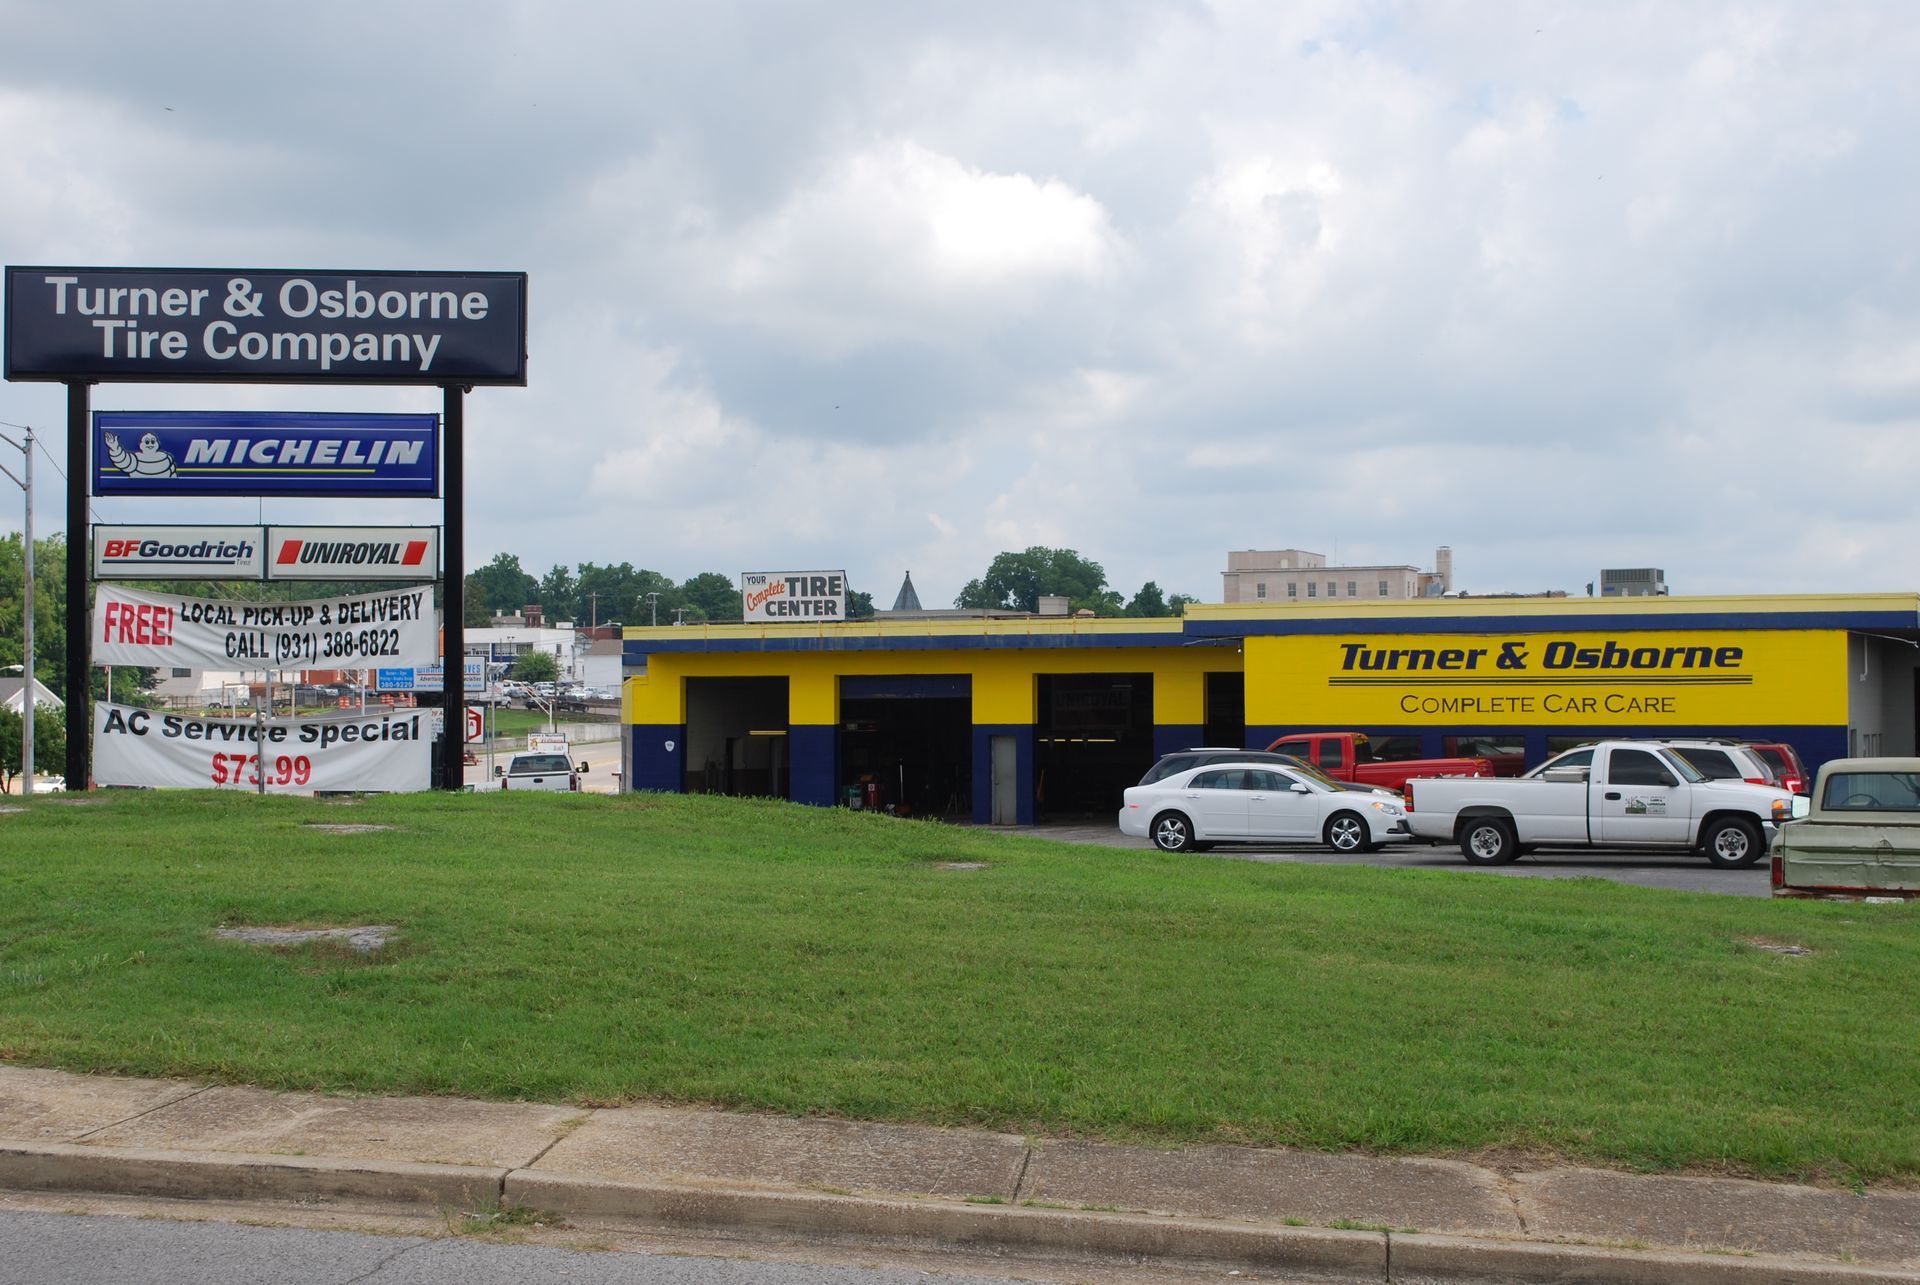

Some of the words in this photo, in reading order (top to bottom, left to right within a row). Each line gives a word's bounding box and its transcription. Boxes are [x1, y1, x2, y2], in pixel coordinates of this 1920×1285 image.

[45, 277, 209, 316] Turner
[223, 278, 265, 318] &
[279, 279, 489, 319] Osborne
[93, 320, 188, 359] Tire
[203, 321, 441, 370] Company
[184, 439, 424, 465] MICHELIN
[103, 539, 254, 558] BFGoodrich
[300, 542, 401, 565] UNIROYAL
[746, 576, 766, 584] YOUR
[747, 579, 785, 611] Complete
[785, 576, 841, 597] TIRE
[181, 602, 237, 625] LOCAL
[242, 605, 314, 626] PICK-UP
[320, 604, 331, 624] &
[338, 593, 423, 623] DELIVERY
[765, 600, 837, 616] CENTER
[104, 602, 174, 646] FREE!
[225, 631, 270, 659] CALL
[275, 632, 317, 665] (931)
[323, 628, 400, 657] 388-6822
[1340, 643, 1488, 671] Turner
[1496, 641, 1530, 670] &
[1543, 641, 1743, 669] Osborne
[1400, 694, 1535, 714] COMPLETE
[1543, 694, 1597, 713] CAR
[1604, 694, 1675, 713] CARE
[103, 709, 150, 736] AC
[162, 716, 287, 743] Service
[299, 715, 419, 749] Special
